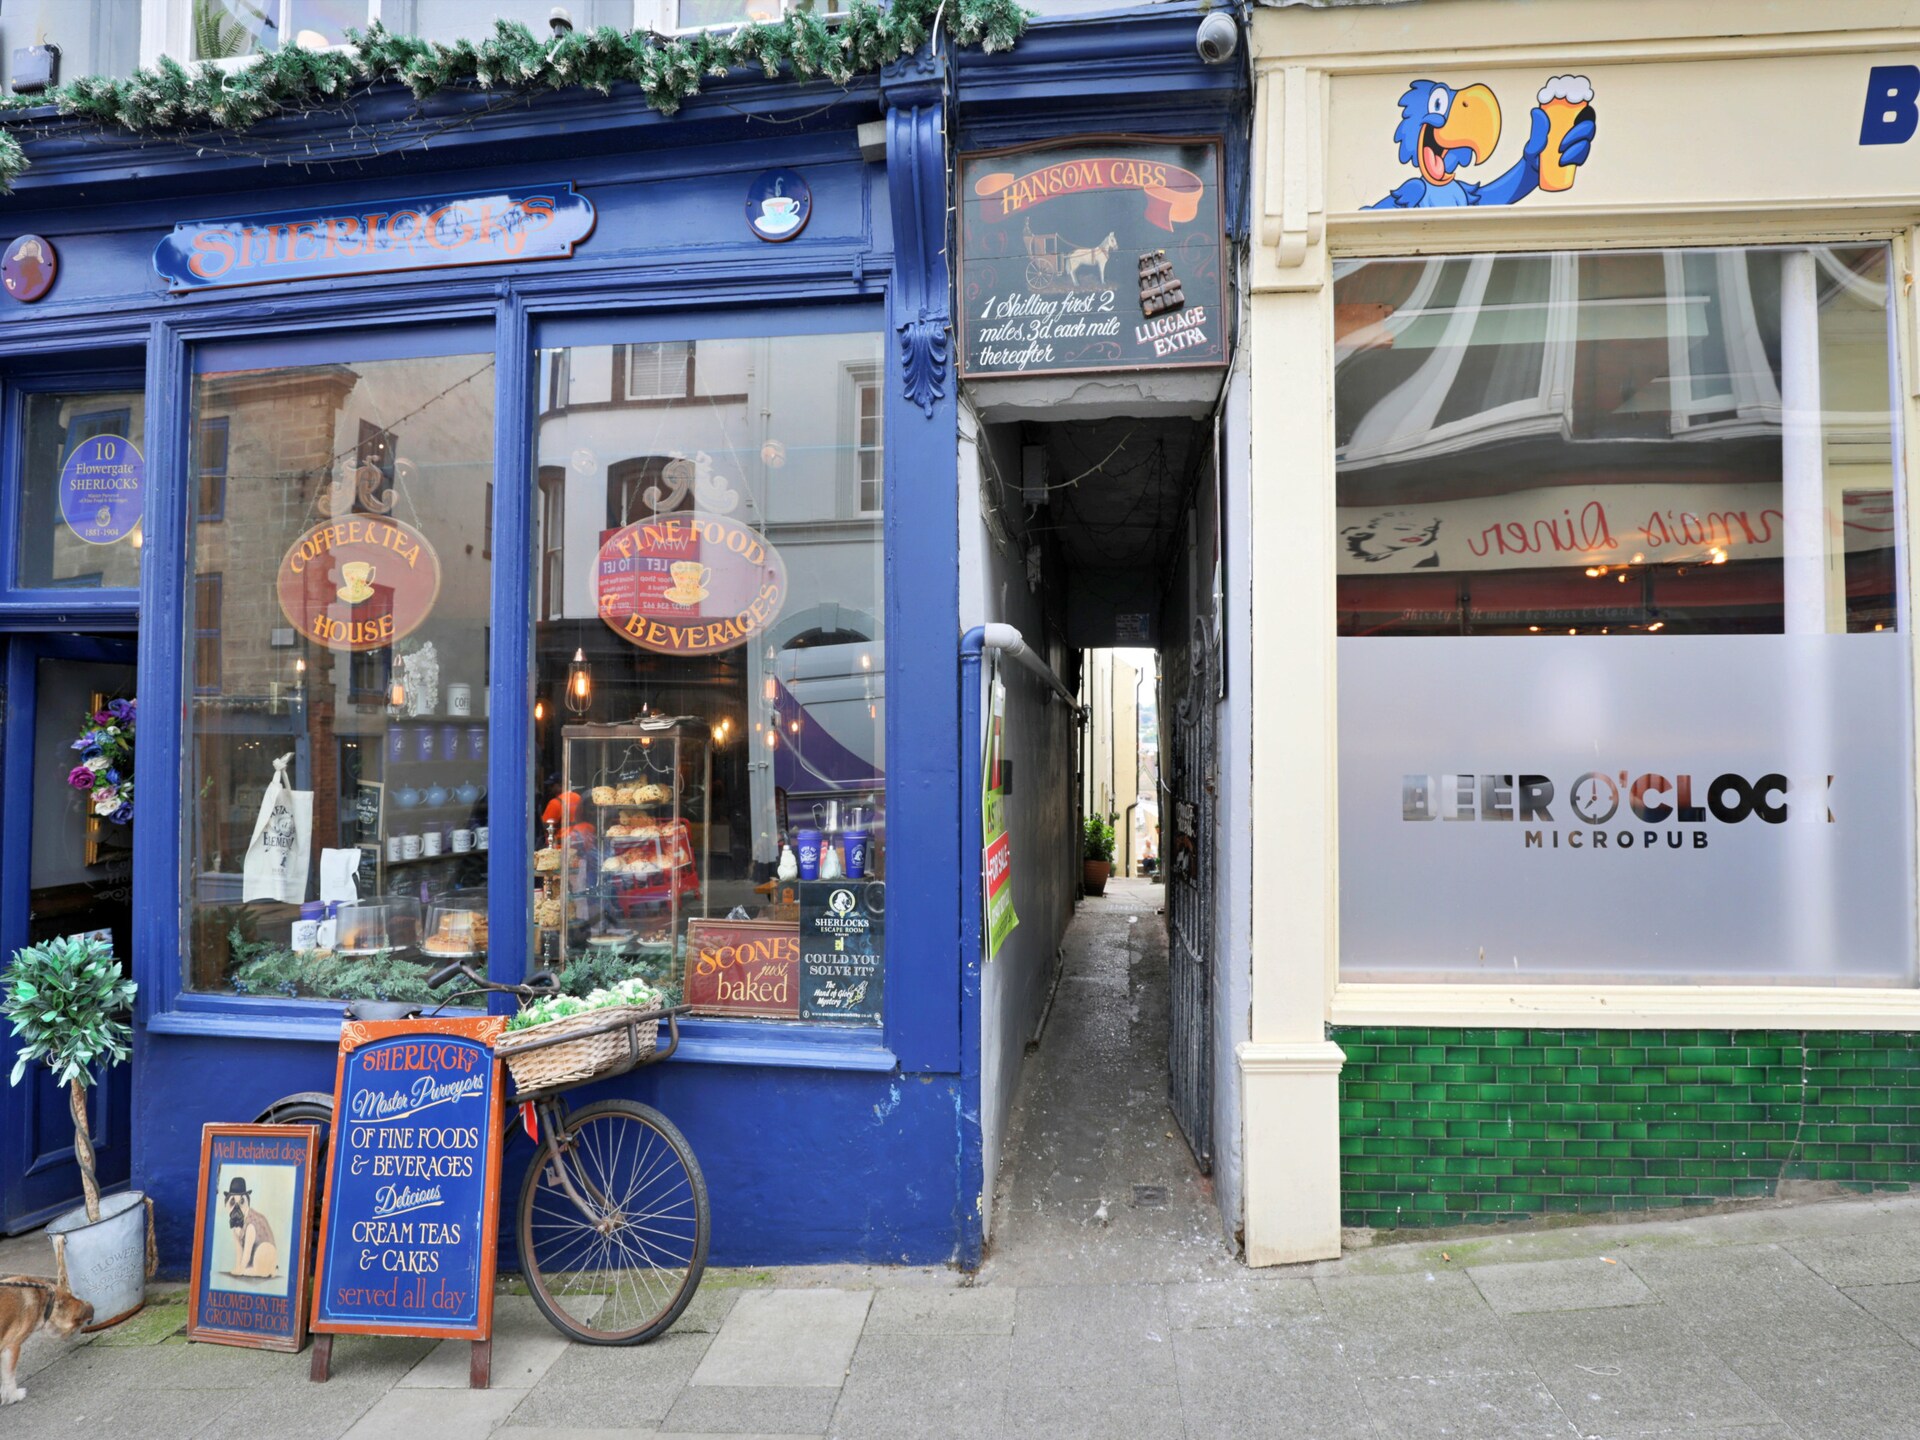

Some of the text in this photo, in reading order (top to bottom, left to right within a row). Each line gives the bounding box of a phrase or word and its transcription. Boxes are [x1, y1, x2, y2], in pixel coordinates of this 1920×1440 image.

[1001, 161, 1167, 215] HANSOM CABS
[188, 196, 556, 278] SHERLOCKS
[980, 290, 1115, 325] 1 Shilling first 2
[978, 318, 1025, 342] miles,
[1054, 317, 1085, 338] each
[1086, 316, 1121, 336] mile
[1136, 306, 1207, 346] LUGGAGE
[1155, 327, 1207, 357] EXTRA
[978, 340, 1056, 371] thereafter
[96, 442, 115, 460] 10
[76, 463, 134, 476] Flowergate
[70, 478, 138, 491] SHERLOCKS
[290, 521, 421, 574] COFFEE & TEA
[617, 519, 683, 560] FINE
[690, 519, 766, 566] FOOD
[624, 583, 779, 649] BEVERAGES
[1401, 607, 1452, 623] Thirsty
[1486, 608, 1520, 620] must
[313, 614, 396, 643] HOUSE
[1402, 770, 1836, 824] BEER O'CLOC
[1525, 830, 1709, 849] MICROPUB
[815, 918, 869, 927] SHERLOCKS
[696, 937, 800, 976] SCONES
[804, 953, 880, 965] COULD YOU
[754, 962, 788, 981] just
[809, 965, 875, 976] SOLVE IT?
[717, 972, 788, 1003] baked
[814, 988, 831, 997] Hand
[830, 989, 838, 998] of
[817, 997, 842, 1008] Mystery
[363, 1044, 478, 1073] SHERLOCKS
[352, 1073, 485, 1119] Master Purveyors
[351, 1127, 479, 1150] OF FINE FOODS
[213, 1141, 307, 1167] Well behaved dogs
[351, 1154, 473, 1180] & BEVERAGES
[374, 1183, 442, 1215] Delicious
[352, 1221, 461, 1246] CREAM TEAS
[359, 1249, 439, 1275] & CAKES
[206, 1291, 289, 1315] ALLOWED ON THE
[337, 1276, 467, 1315] served all day
[205, 1308, 289, 1332] GROUND FLOOR
